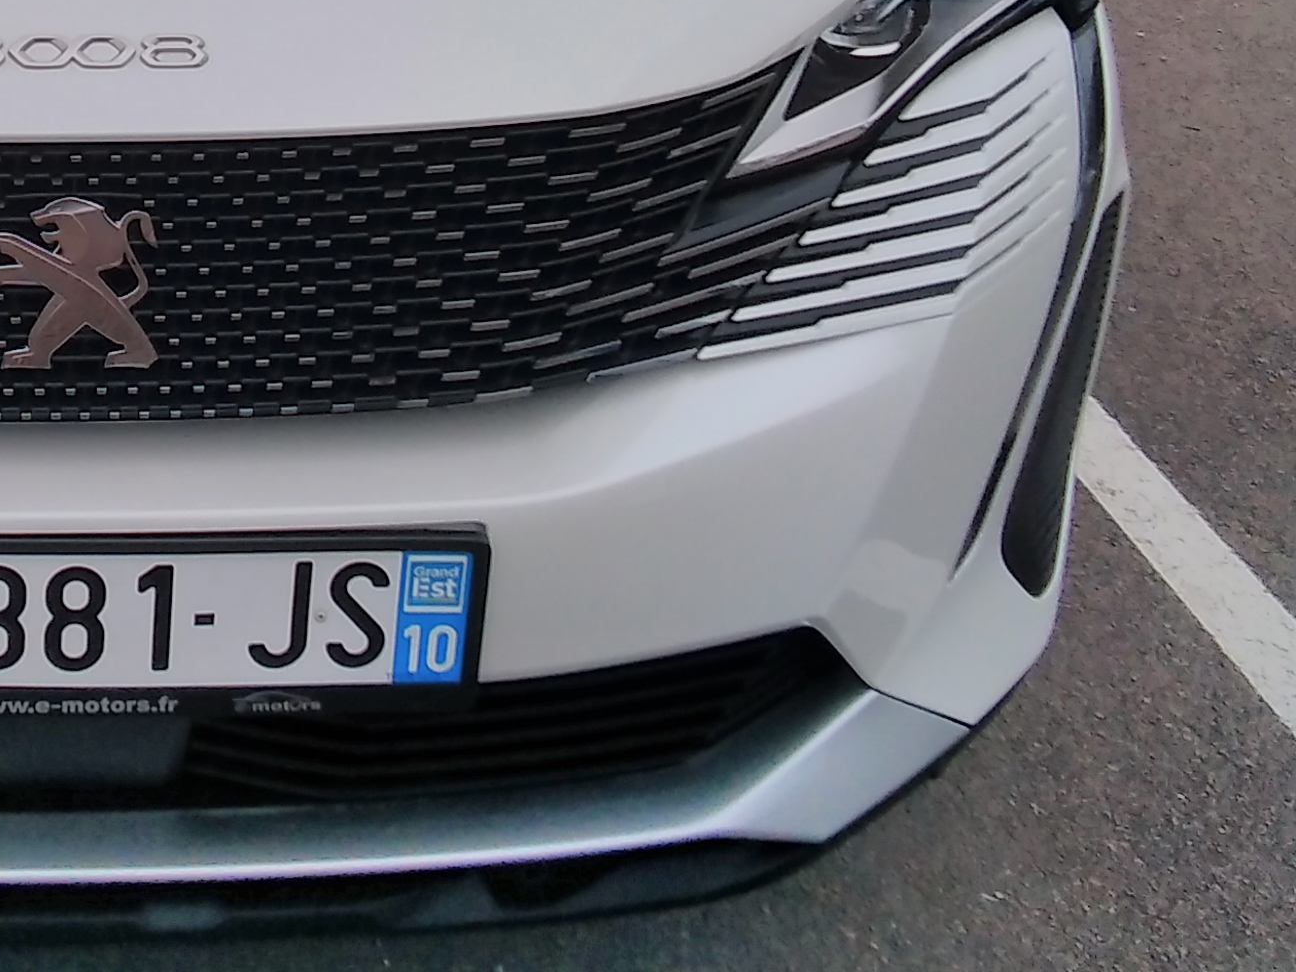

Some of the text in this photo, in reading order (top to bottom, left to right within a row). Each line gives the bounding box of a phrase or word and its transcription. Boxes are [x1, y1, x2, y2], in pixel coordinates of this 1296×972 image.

[413, 566, 460, 577] Grand
[412, 576, 458, 598] Est
[403, 624, 459, 673] 10
